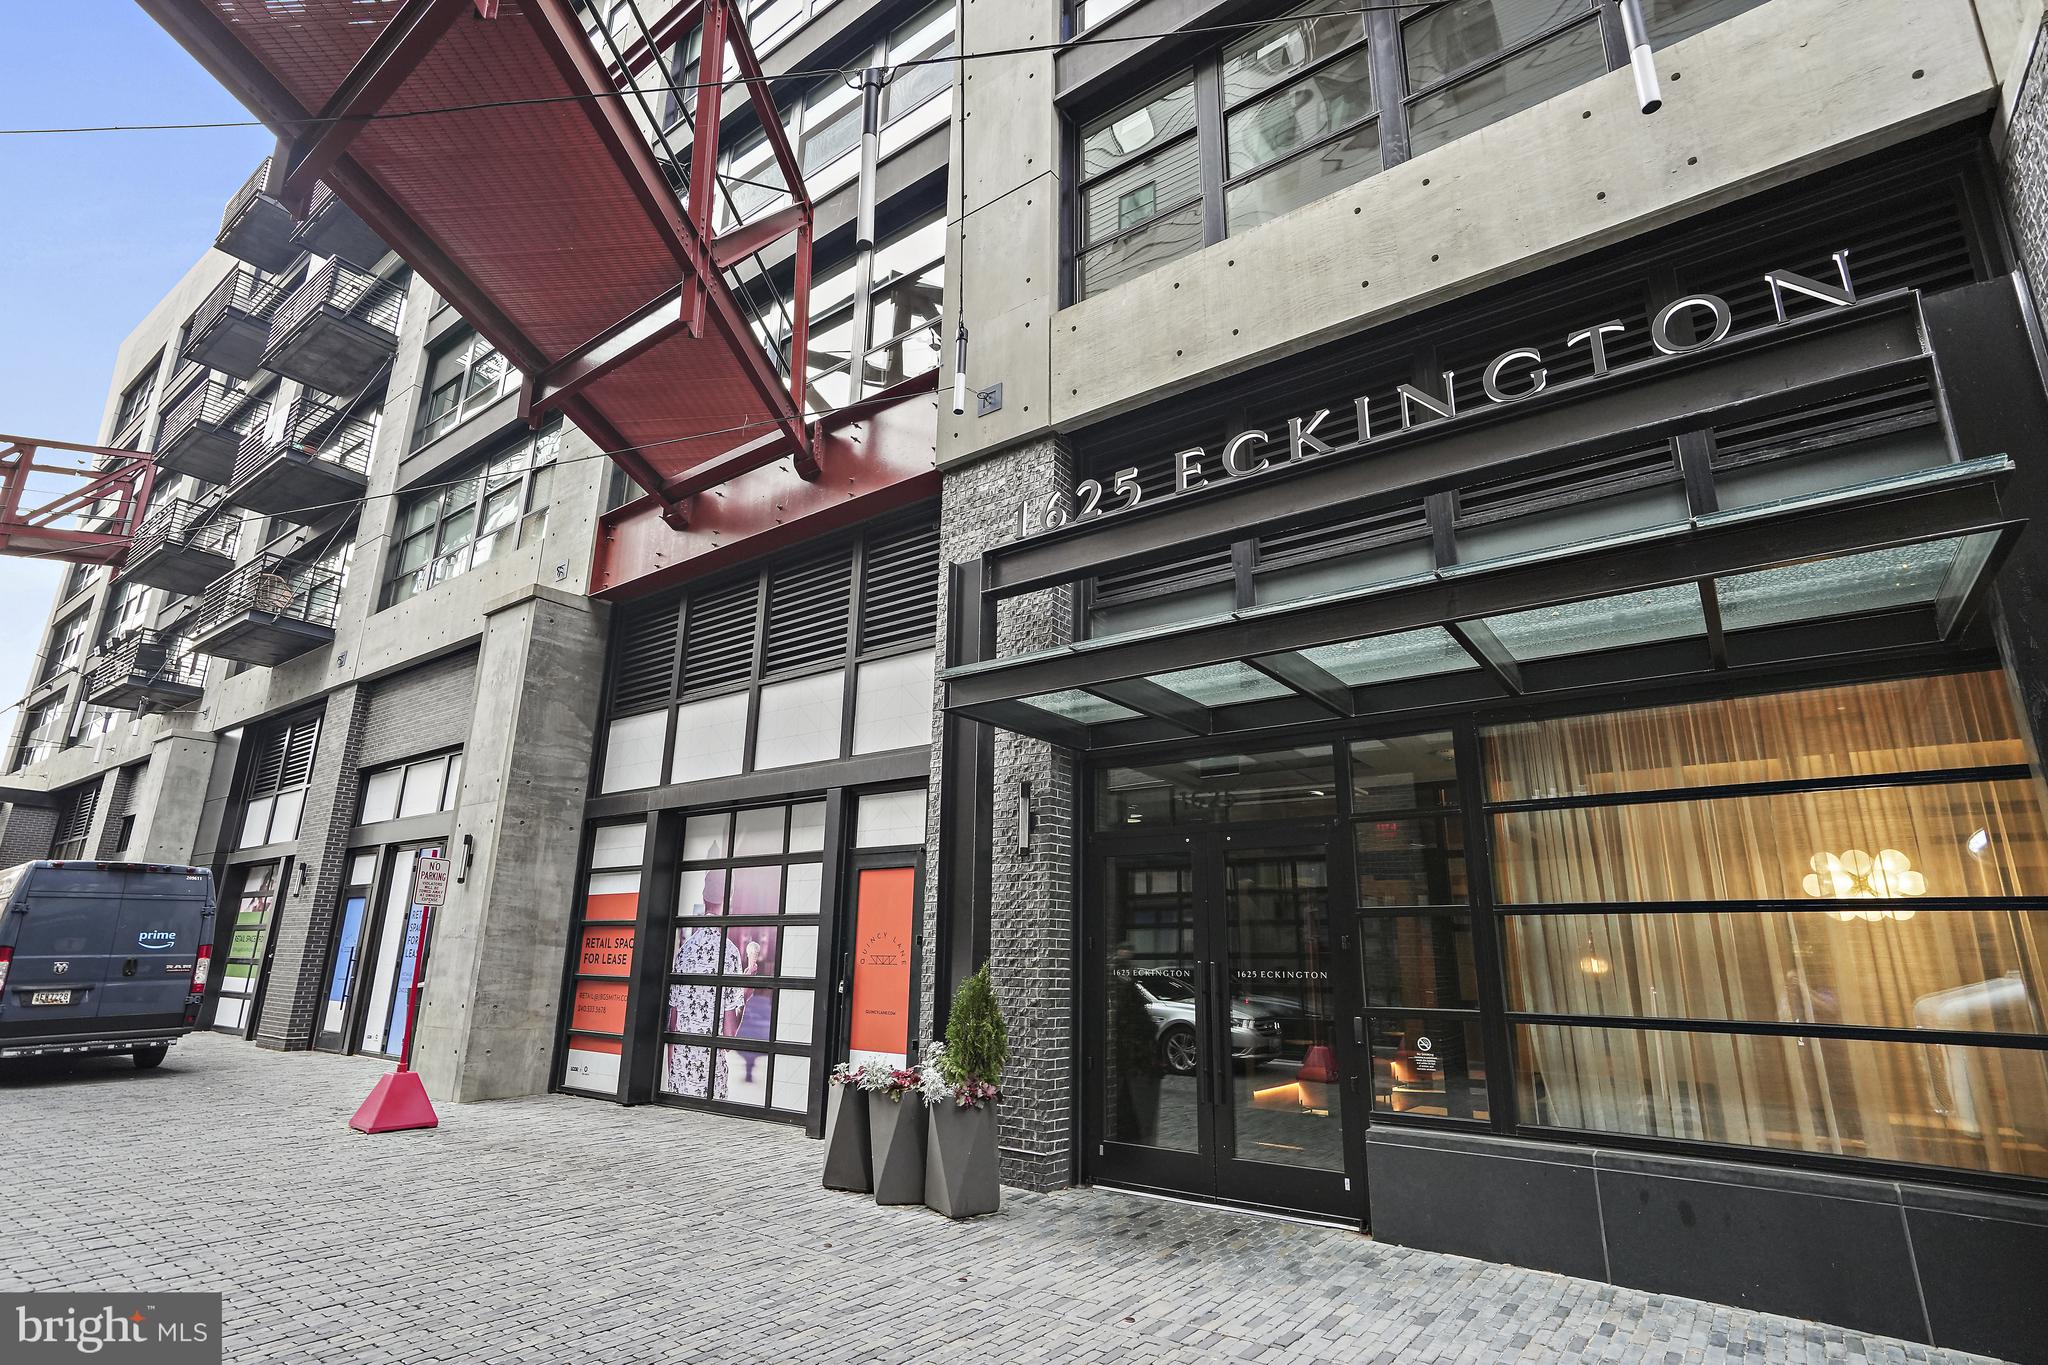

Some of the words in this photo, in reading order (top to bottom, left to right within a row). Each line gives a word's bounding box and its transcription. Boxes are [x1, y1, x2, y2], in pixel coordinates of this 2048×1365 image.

[1013, 467, 1142, 541] 1625
[1174, 248, 1857, 496] ECKINGTON
[429, 862, 441, 871] NO
[421, 871, 446, 881] PARKING
[138, 930, 177, 942] prime
[586, 938, 612, 949] RETAIL
[614, 937, 635, 949] SPAC
[860, 931, 888, 965] QUINCY
[892, 936, 907, 965] LANE
[583, 953, 600, 964] FOR
[602, 954, 627, 965] LEASE
[1113, 969, 1130, 977] 1625
[1133, 969, 1191, 978] ECKINGTON
[1236, 970, 1257, 979] 1625
[1260, 970, 1328, 980] ECKINGTON
[579, 993, 628, 1002] RETAIL@JBGSMITH.CO
